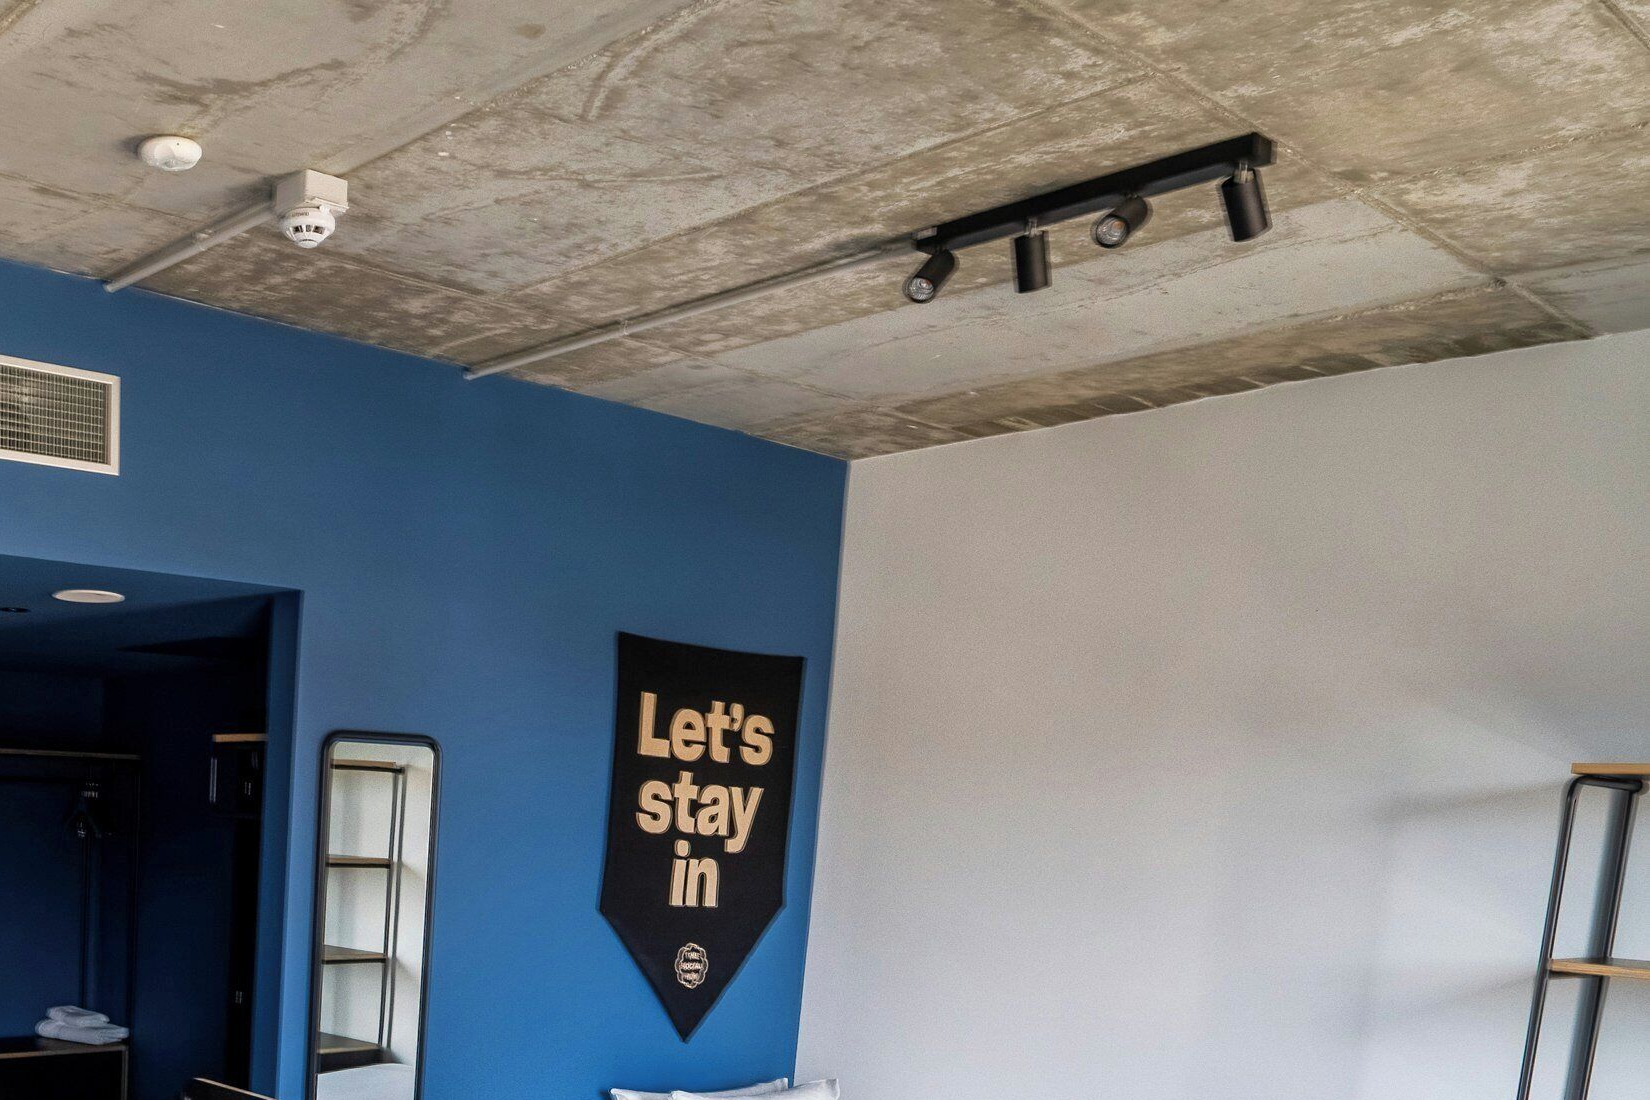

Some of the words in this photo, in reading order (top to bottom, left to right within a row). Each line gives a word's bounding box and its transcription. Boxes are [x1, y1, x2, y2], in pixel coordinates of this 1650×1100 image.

[636, 691, 775, 765] Let’s
[635, 771, 765, 853] stay
[668, 839, 721, 908] in
